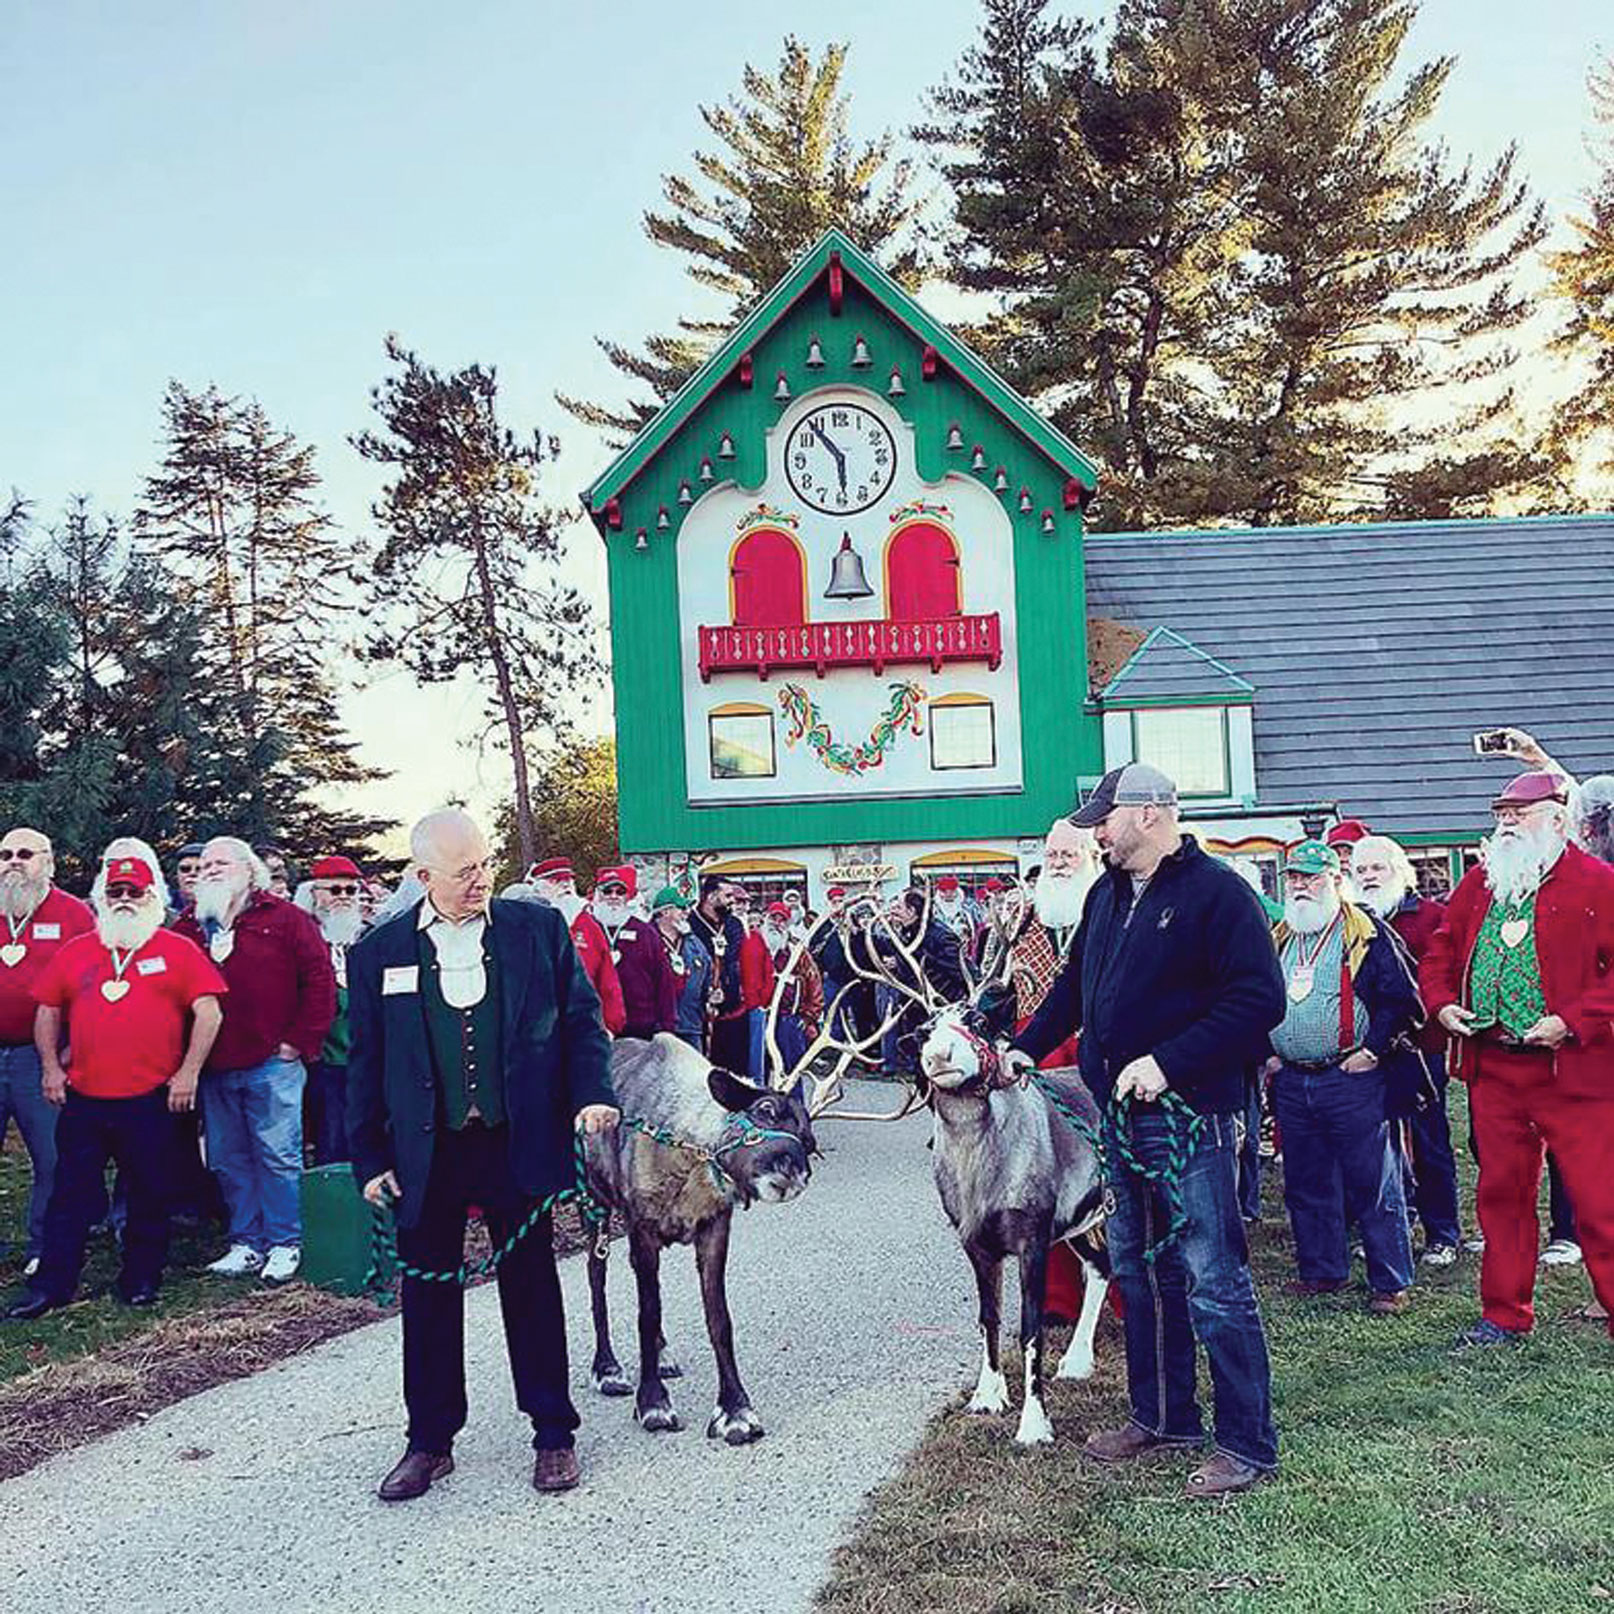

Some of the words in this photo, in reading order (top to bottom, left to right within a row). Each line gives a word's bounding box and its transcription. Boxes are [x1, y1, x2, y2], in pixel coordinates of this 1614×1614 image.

[814, 416, 825, 432] 11
[831, 411, 849, 428] 12
[856, 415, 862, 431] 1
[800, 432, 815, 448] 10
[868, 430, 882, 447] 2
[794, 452, 806, 470] 9
[874, 448, 888, 466] 3
[802, 473, 813, 490] 8
[869, 470, 881, 486] 4
[815, 487, 828, 503] 7
[836, 491, 848, 507] 6
